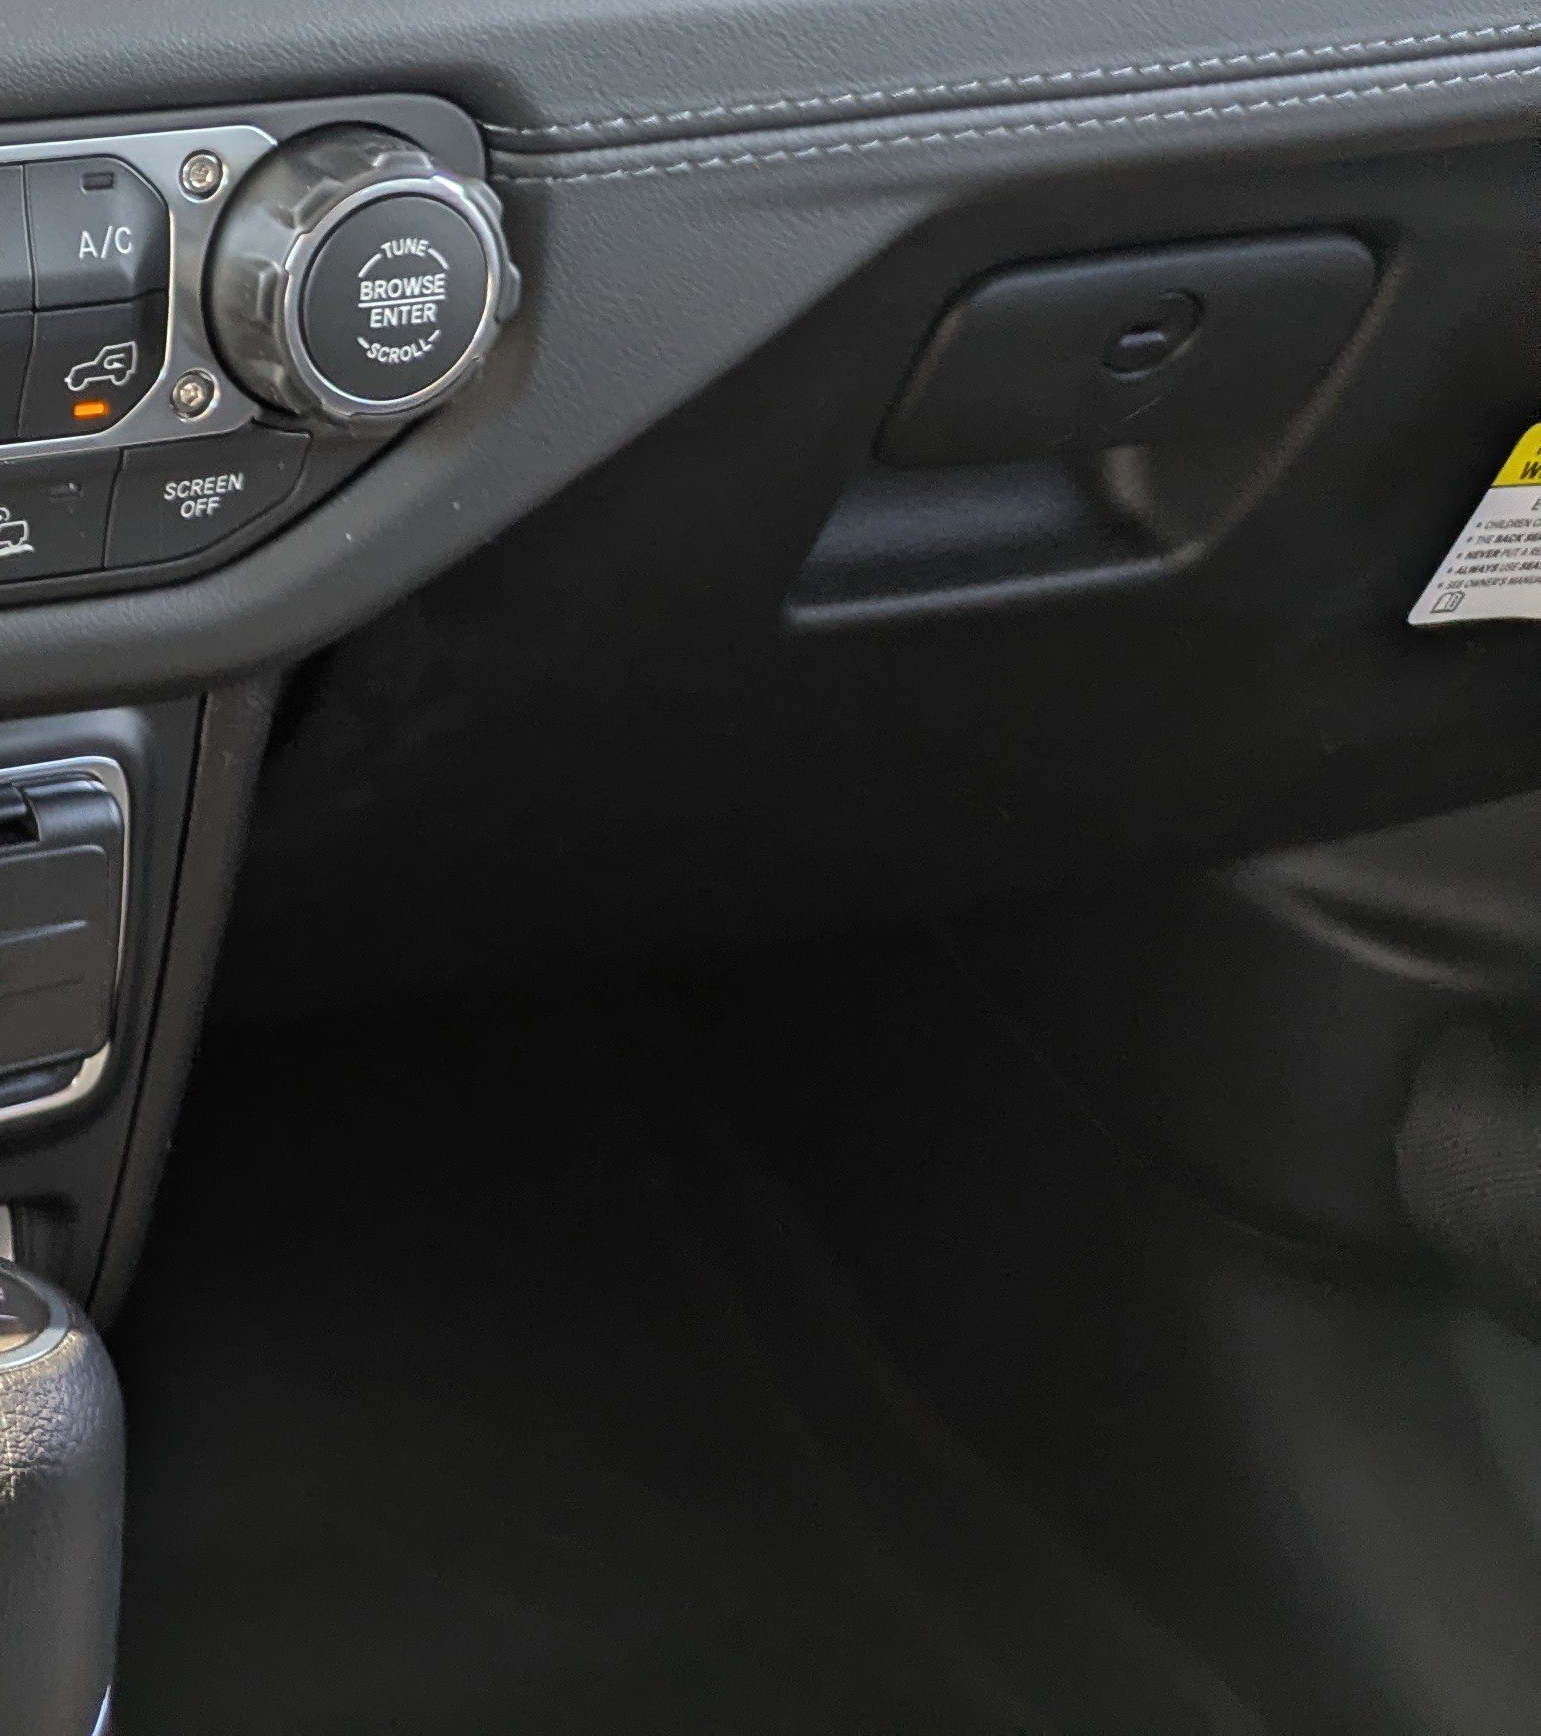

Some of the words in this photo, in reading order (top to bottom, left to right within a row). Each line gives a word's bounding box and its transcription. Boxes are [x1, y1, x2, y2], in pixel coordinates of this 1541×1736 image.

[78, 227, 133, 260] A/C
[381, 239, 430, 258] TUNE
[359, 273, 446, 300] BROWSE
[370, 302, 436, 327] ENTER
[367, 336, 432, 365] SCROLL
[164, 474, 243, 500] SCREEN
[180, 497, 219, 519] OFF
